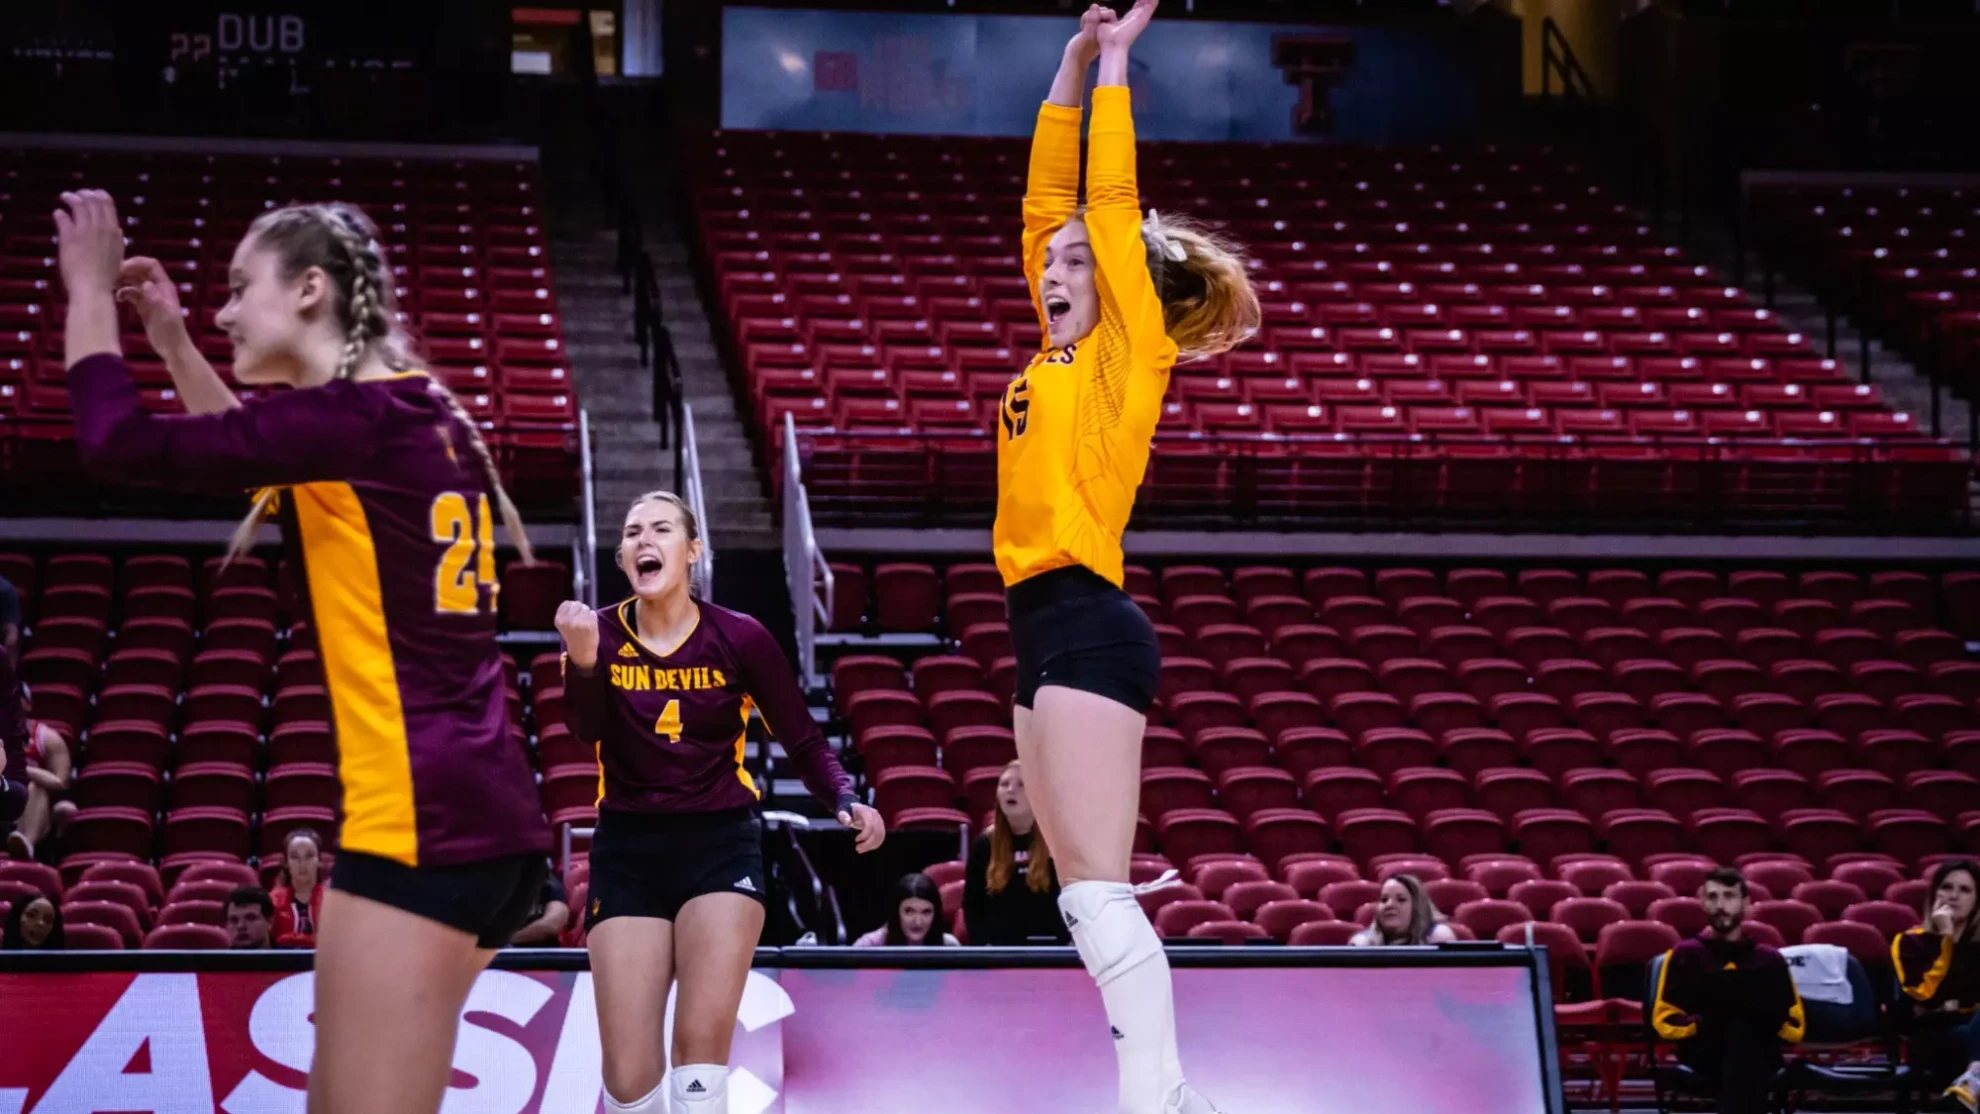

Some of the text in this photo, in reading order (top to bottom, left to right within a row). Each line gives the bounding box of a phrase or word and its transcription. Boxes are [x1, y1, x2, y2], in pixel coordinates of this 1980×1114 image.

[217, 12, 306, 53] DUB
[610, 664, 727, 690] SUN DEVILS
[654, 699, 684, 743] 4
